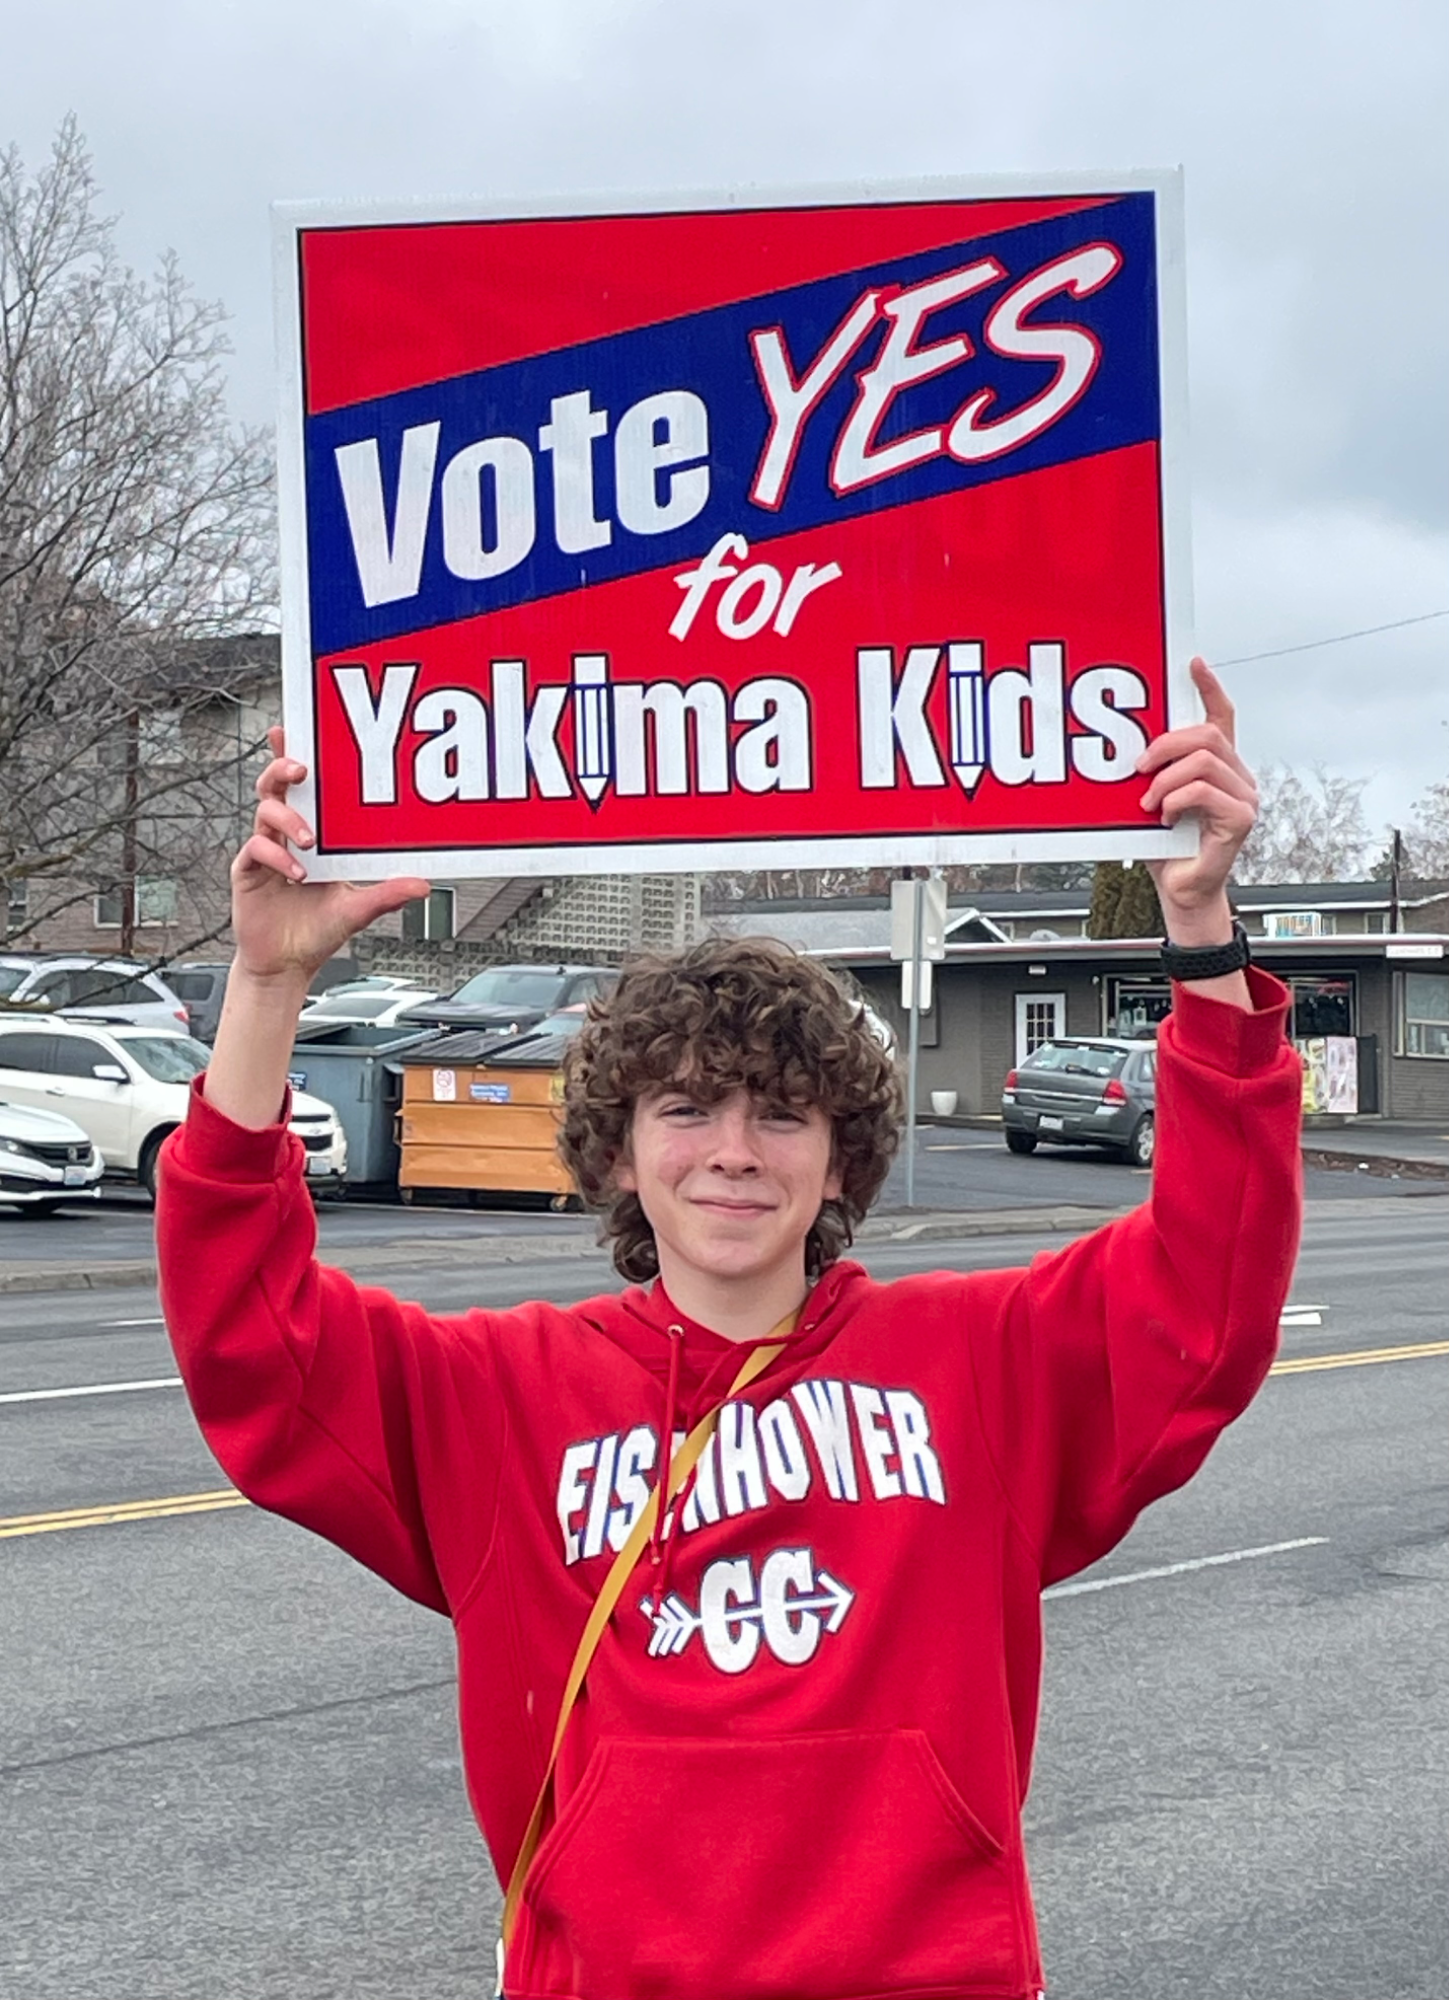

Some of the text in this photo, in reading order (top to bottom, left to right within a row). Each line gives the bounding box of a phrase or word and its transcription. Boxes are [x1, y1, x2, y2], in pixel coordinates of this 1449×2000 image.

[334, 241, 1123, 608] Vote YES
[668, 533, 842, 641] for
[330, 640, 1152, 813] Yakima Kids
[699, 1546, 822, 1674] CC
